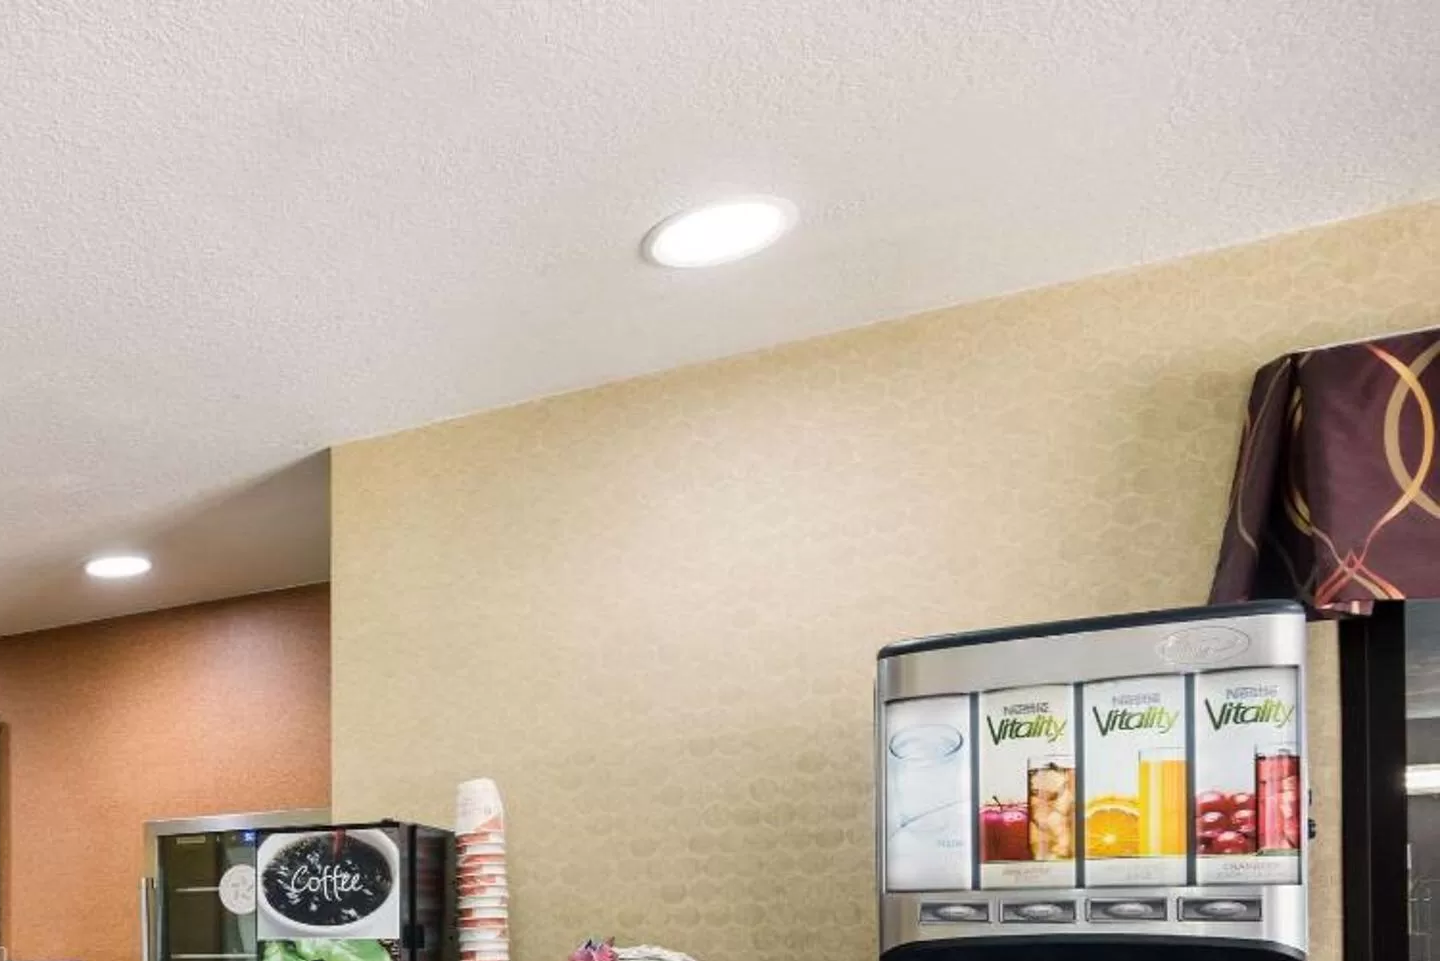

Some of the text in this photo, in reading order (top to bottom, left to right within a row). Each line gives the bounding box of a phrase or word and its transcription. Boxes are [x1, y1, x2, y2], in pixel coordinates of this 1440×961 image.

[986, 714, 1068, 746] Vitality
[1091, 705, 1180, 737] Vitality
[1204, 698, 1295, 731] Vitality
[290, 865, 364, 901] Coffee
